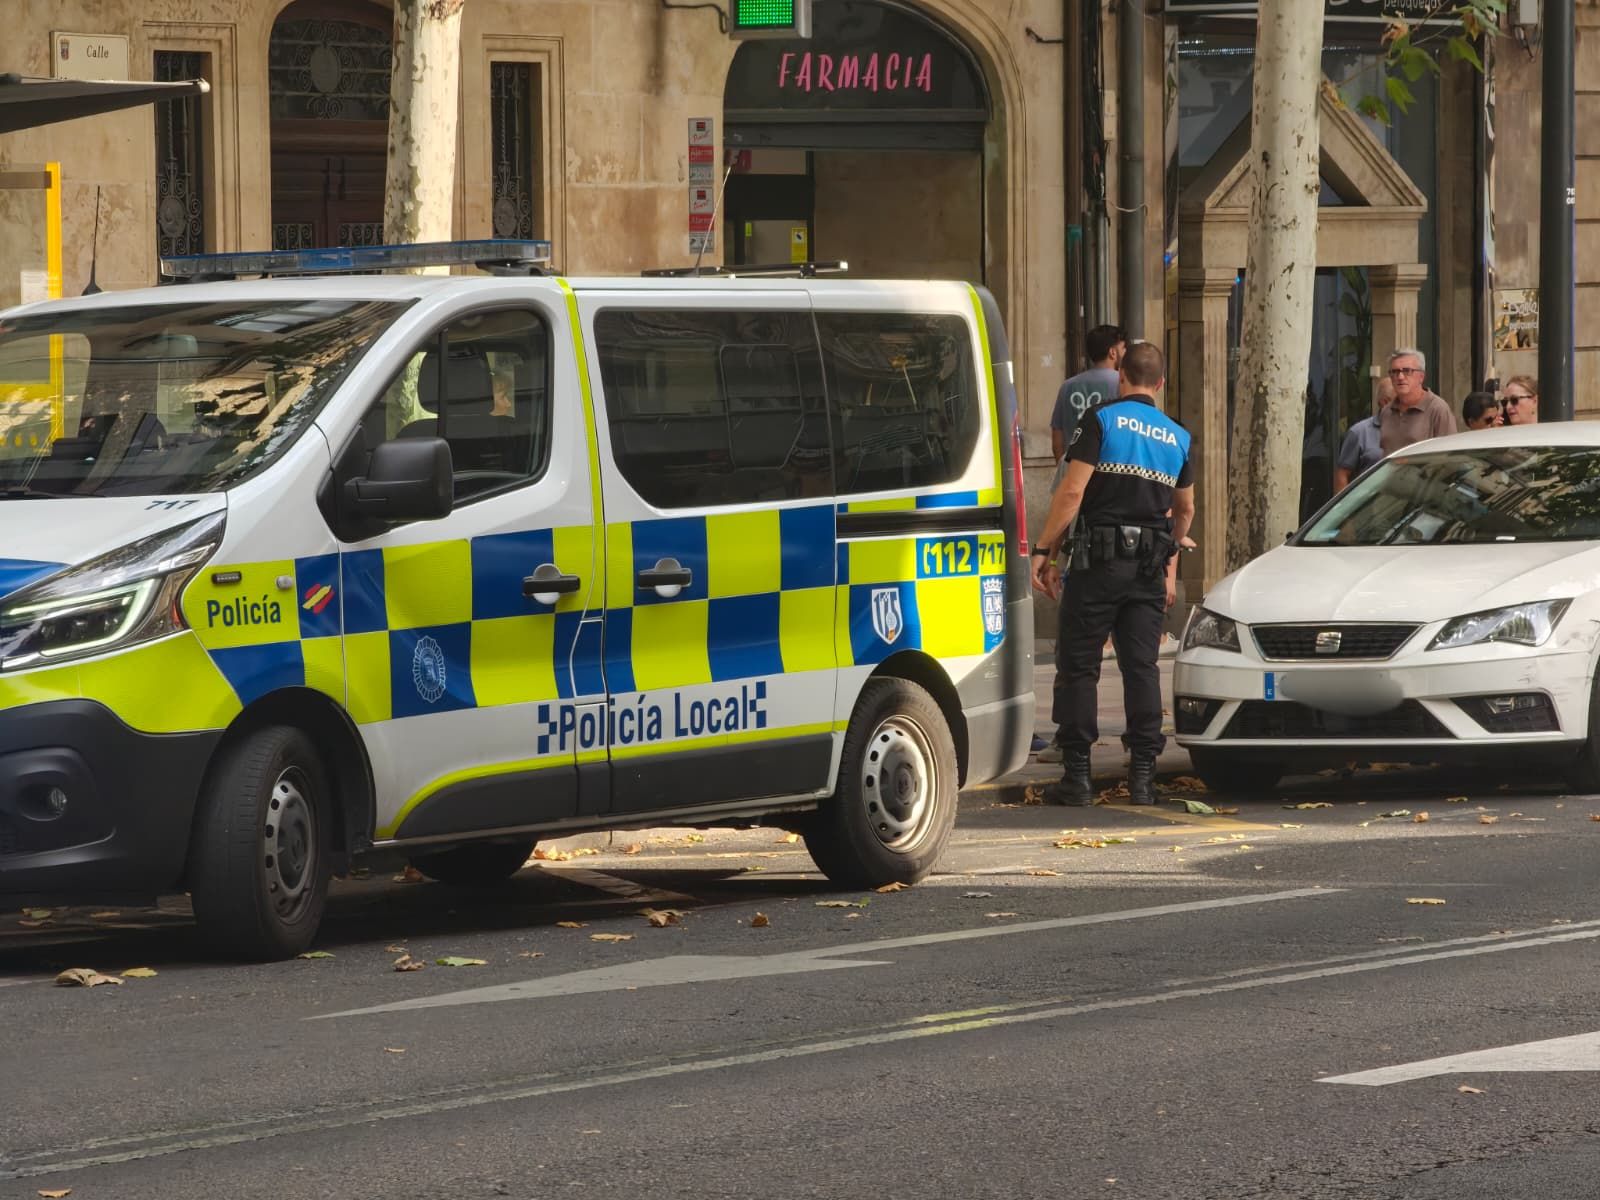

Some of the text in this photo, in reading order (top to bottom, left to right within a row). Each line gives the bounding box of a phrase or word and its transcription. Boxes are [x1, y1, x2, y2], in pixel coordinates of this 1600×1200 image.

[86, 44, 109, 59] Calle
[778, 52, 932, 93] FARMACIA
[1117, 416, 1177, 447] POLICÍA
[144, 499, 200, 510] 717
[930, 541, 972, 575] 112
[979, 542, 1004, 566] 717
[207, 594, 281, 628] Policía
[560, 685, 748, 751] Policía Local
